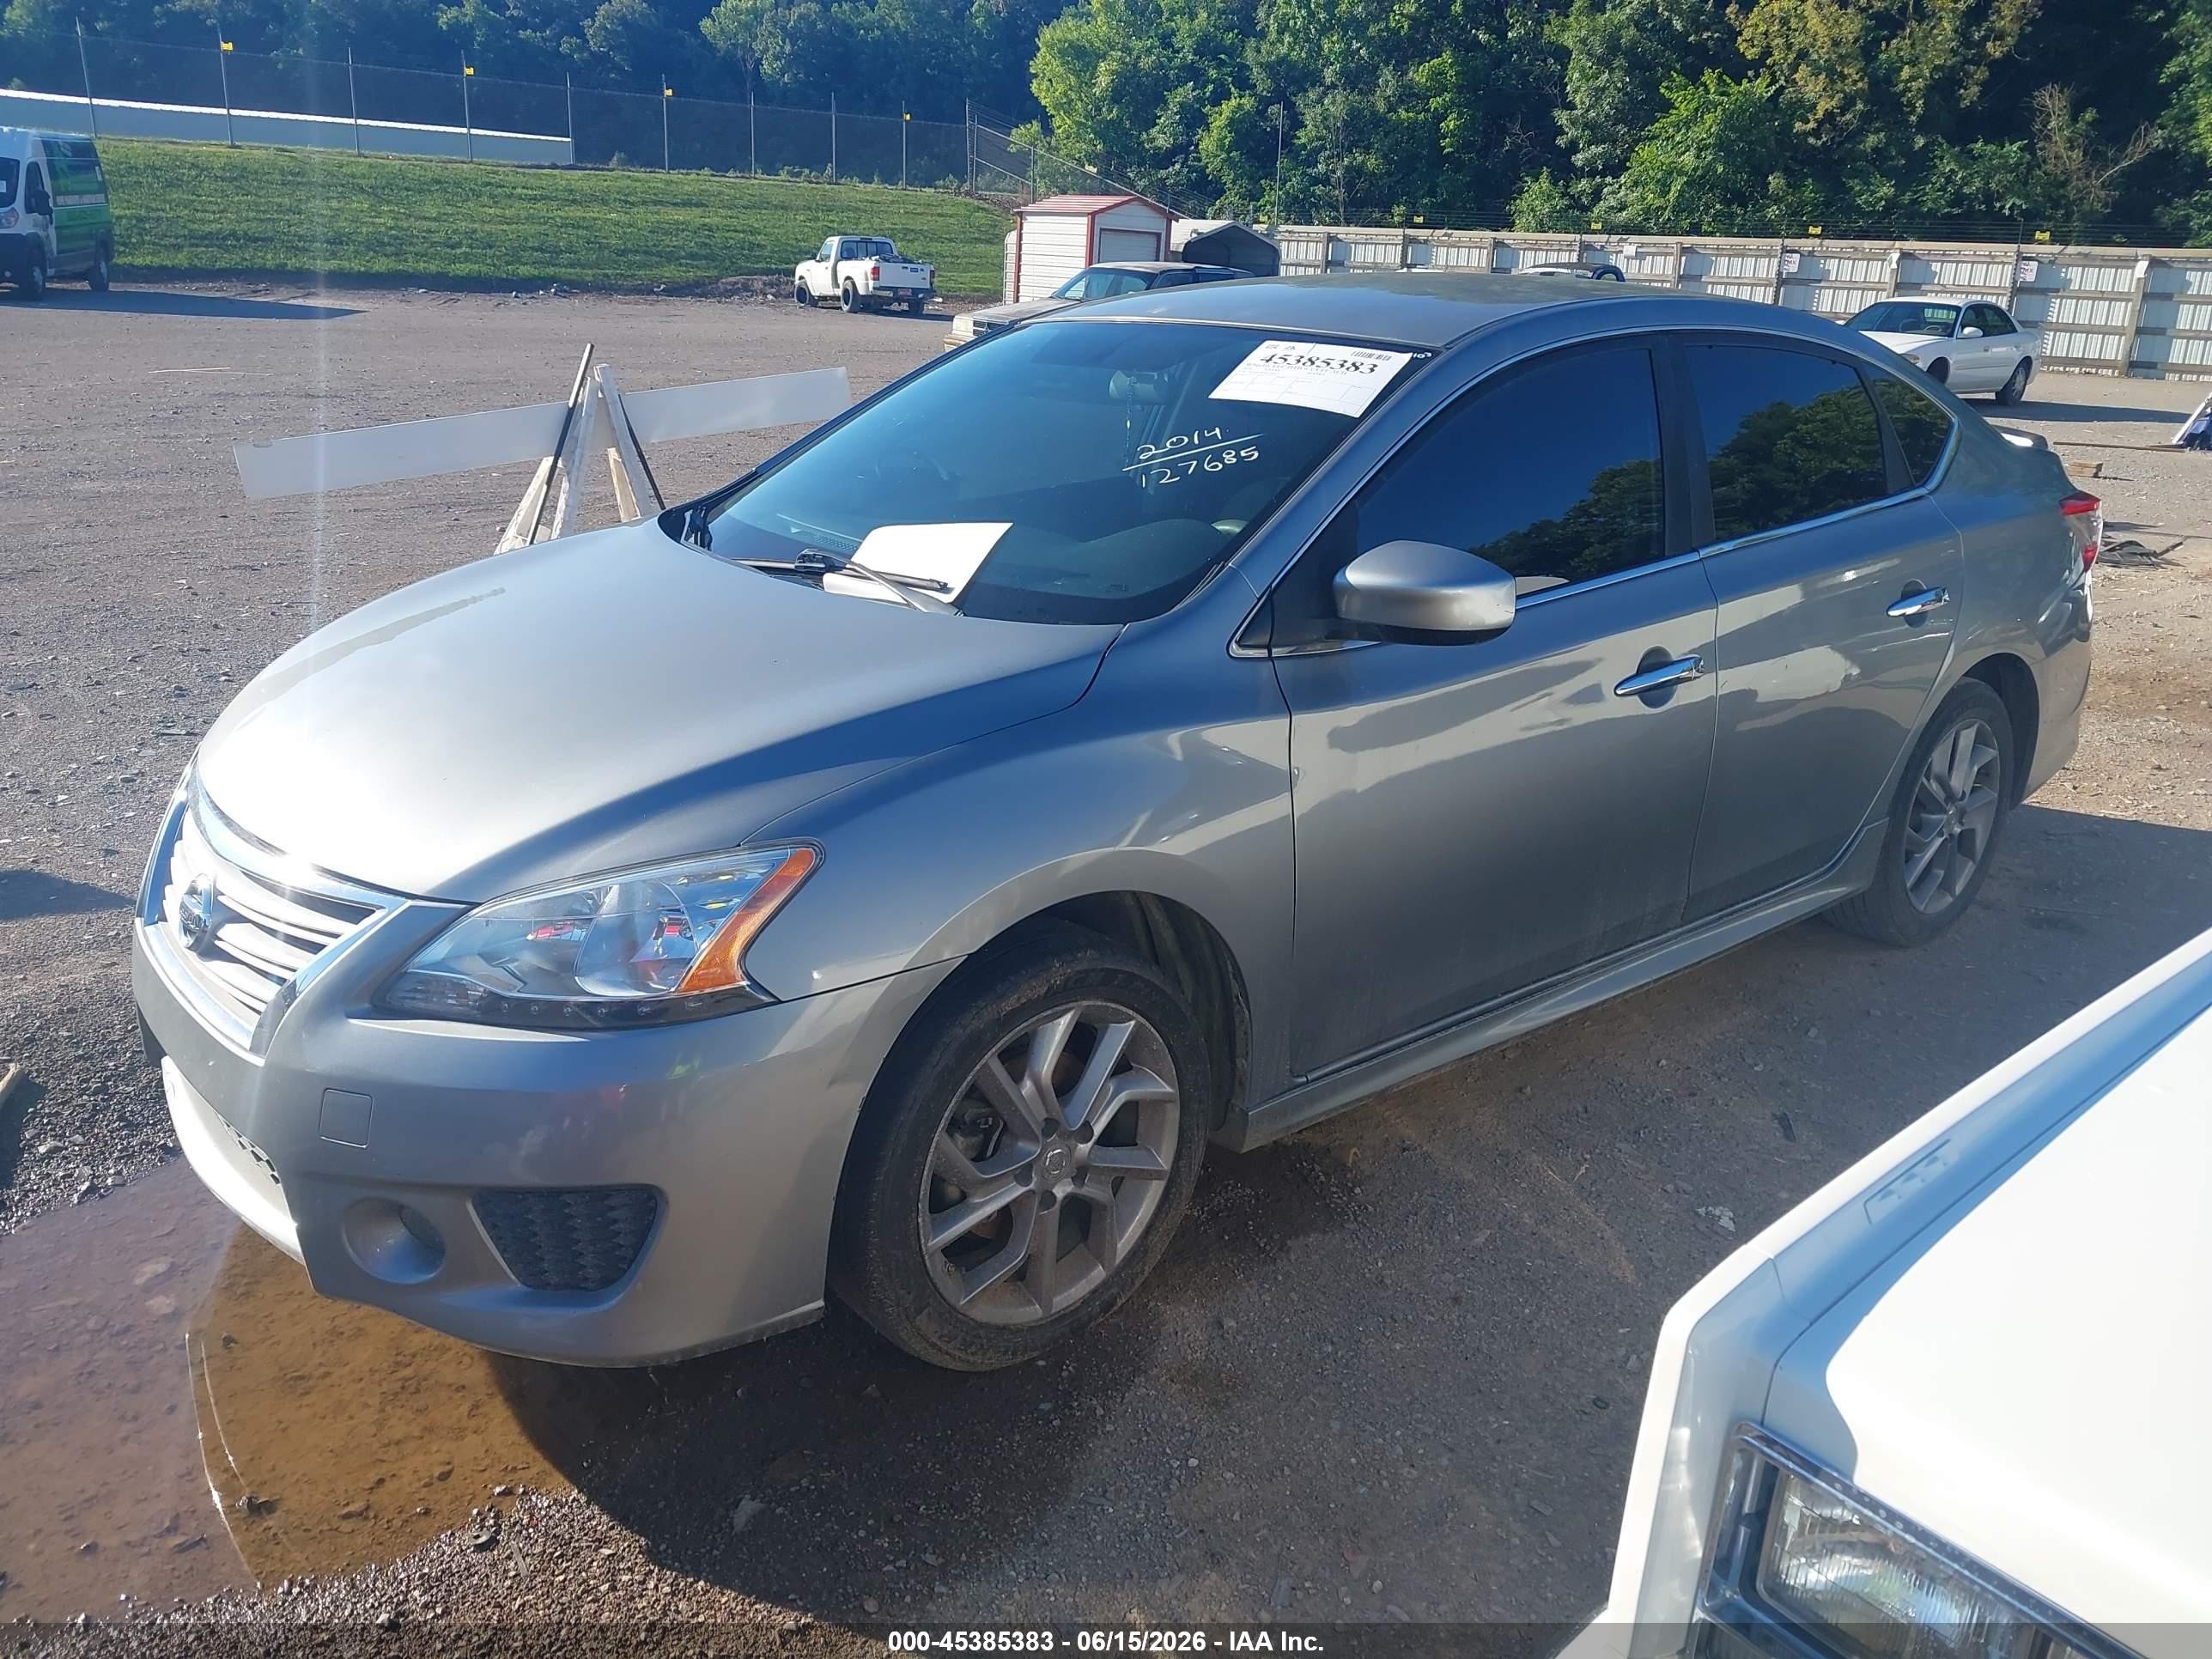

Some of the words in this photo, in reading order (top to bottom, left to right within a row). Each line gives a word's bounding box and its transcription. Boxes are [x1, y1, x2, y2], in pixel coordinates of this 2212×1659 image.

[1260, 353, 1379, 374] 45385383
[1136, 427, 1223, 459] 2014
[1141, 446, 1260, 488] 127685
